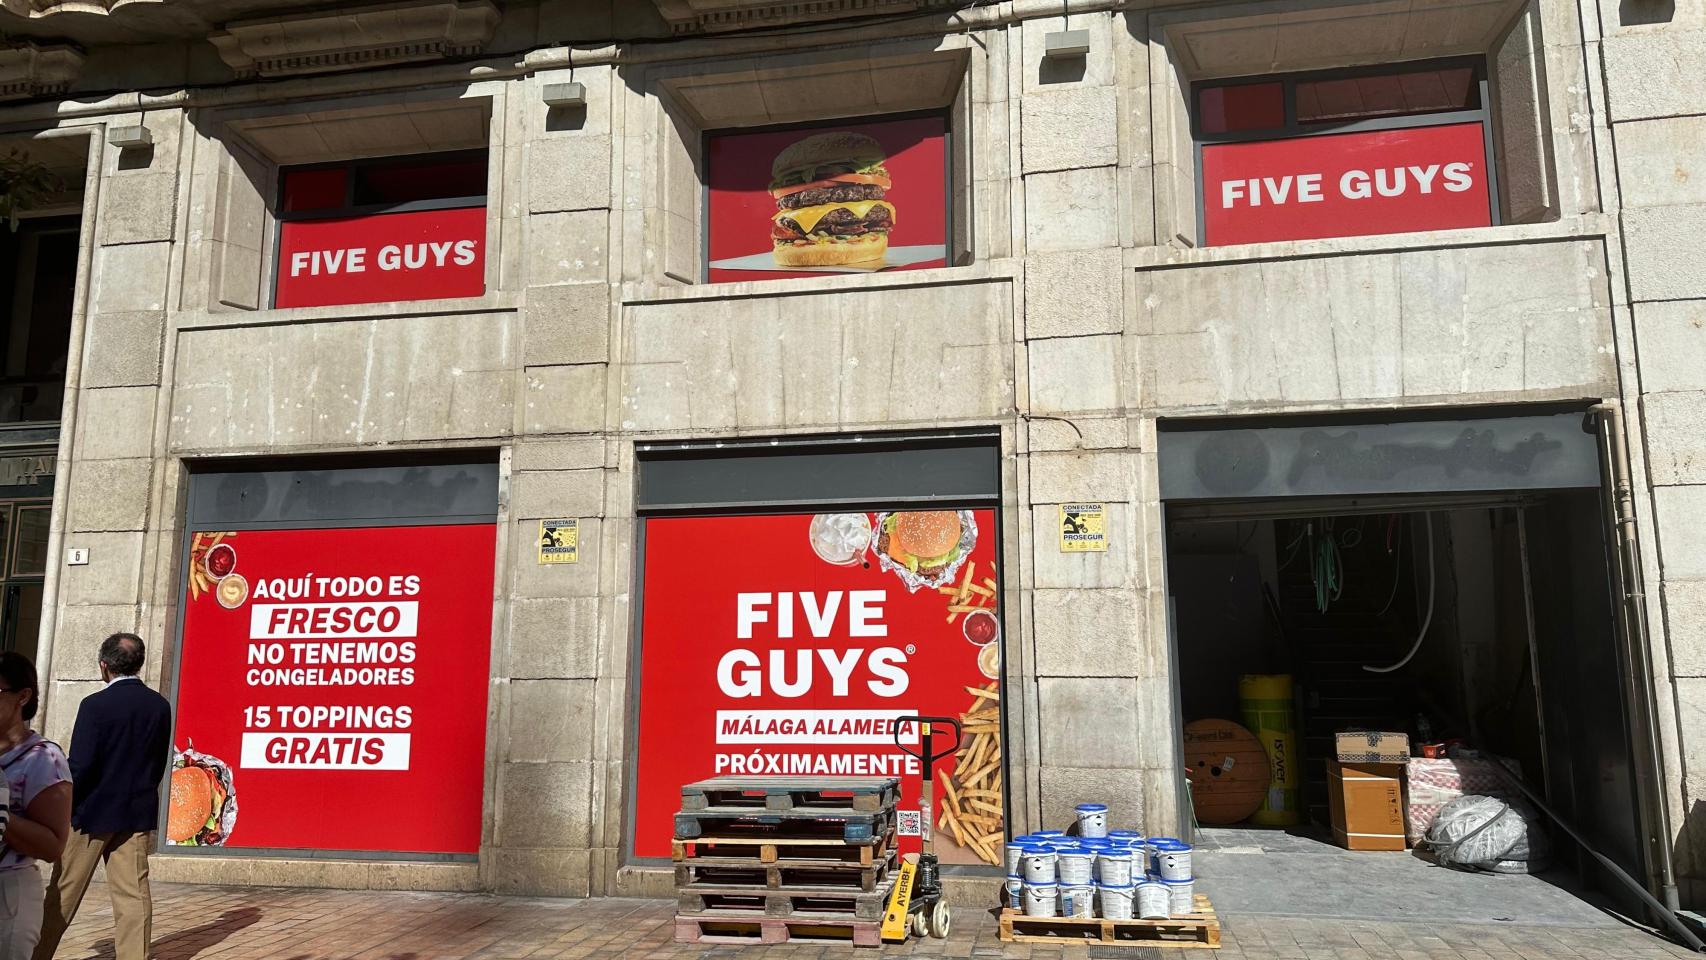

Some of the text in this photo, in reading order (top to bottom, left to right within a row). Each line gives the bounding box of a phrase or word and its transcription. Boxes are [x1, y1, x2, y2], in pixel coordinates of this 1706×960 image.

[1222, 173, 1324, 209] FIVE
[290, 247, 367, 277] FIVE
[75, 550, 81, 561] 6
[253, 573, 421, 601] AQUÍ TODO ES
[268, 606, 401, 634] FRESCO
[736, 590, 888, 639] FIVE
[247, 642, 417, 665] NO TENEMOS
[246, 668, 415, 686] CONGELADORES
[243, 705, 413, 728] 15 TOPPINGS
[721, 715, 808, 735] MÁLAGA
[812, 719, 914, 735] ALAMEDA
[265, 737, 385, 764] GRATIS
[715, 749, 920, 775] PRÓXIMAMENTE
[896, 866, 911, 907] AYERBE
